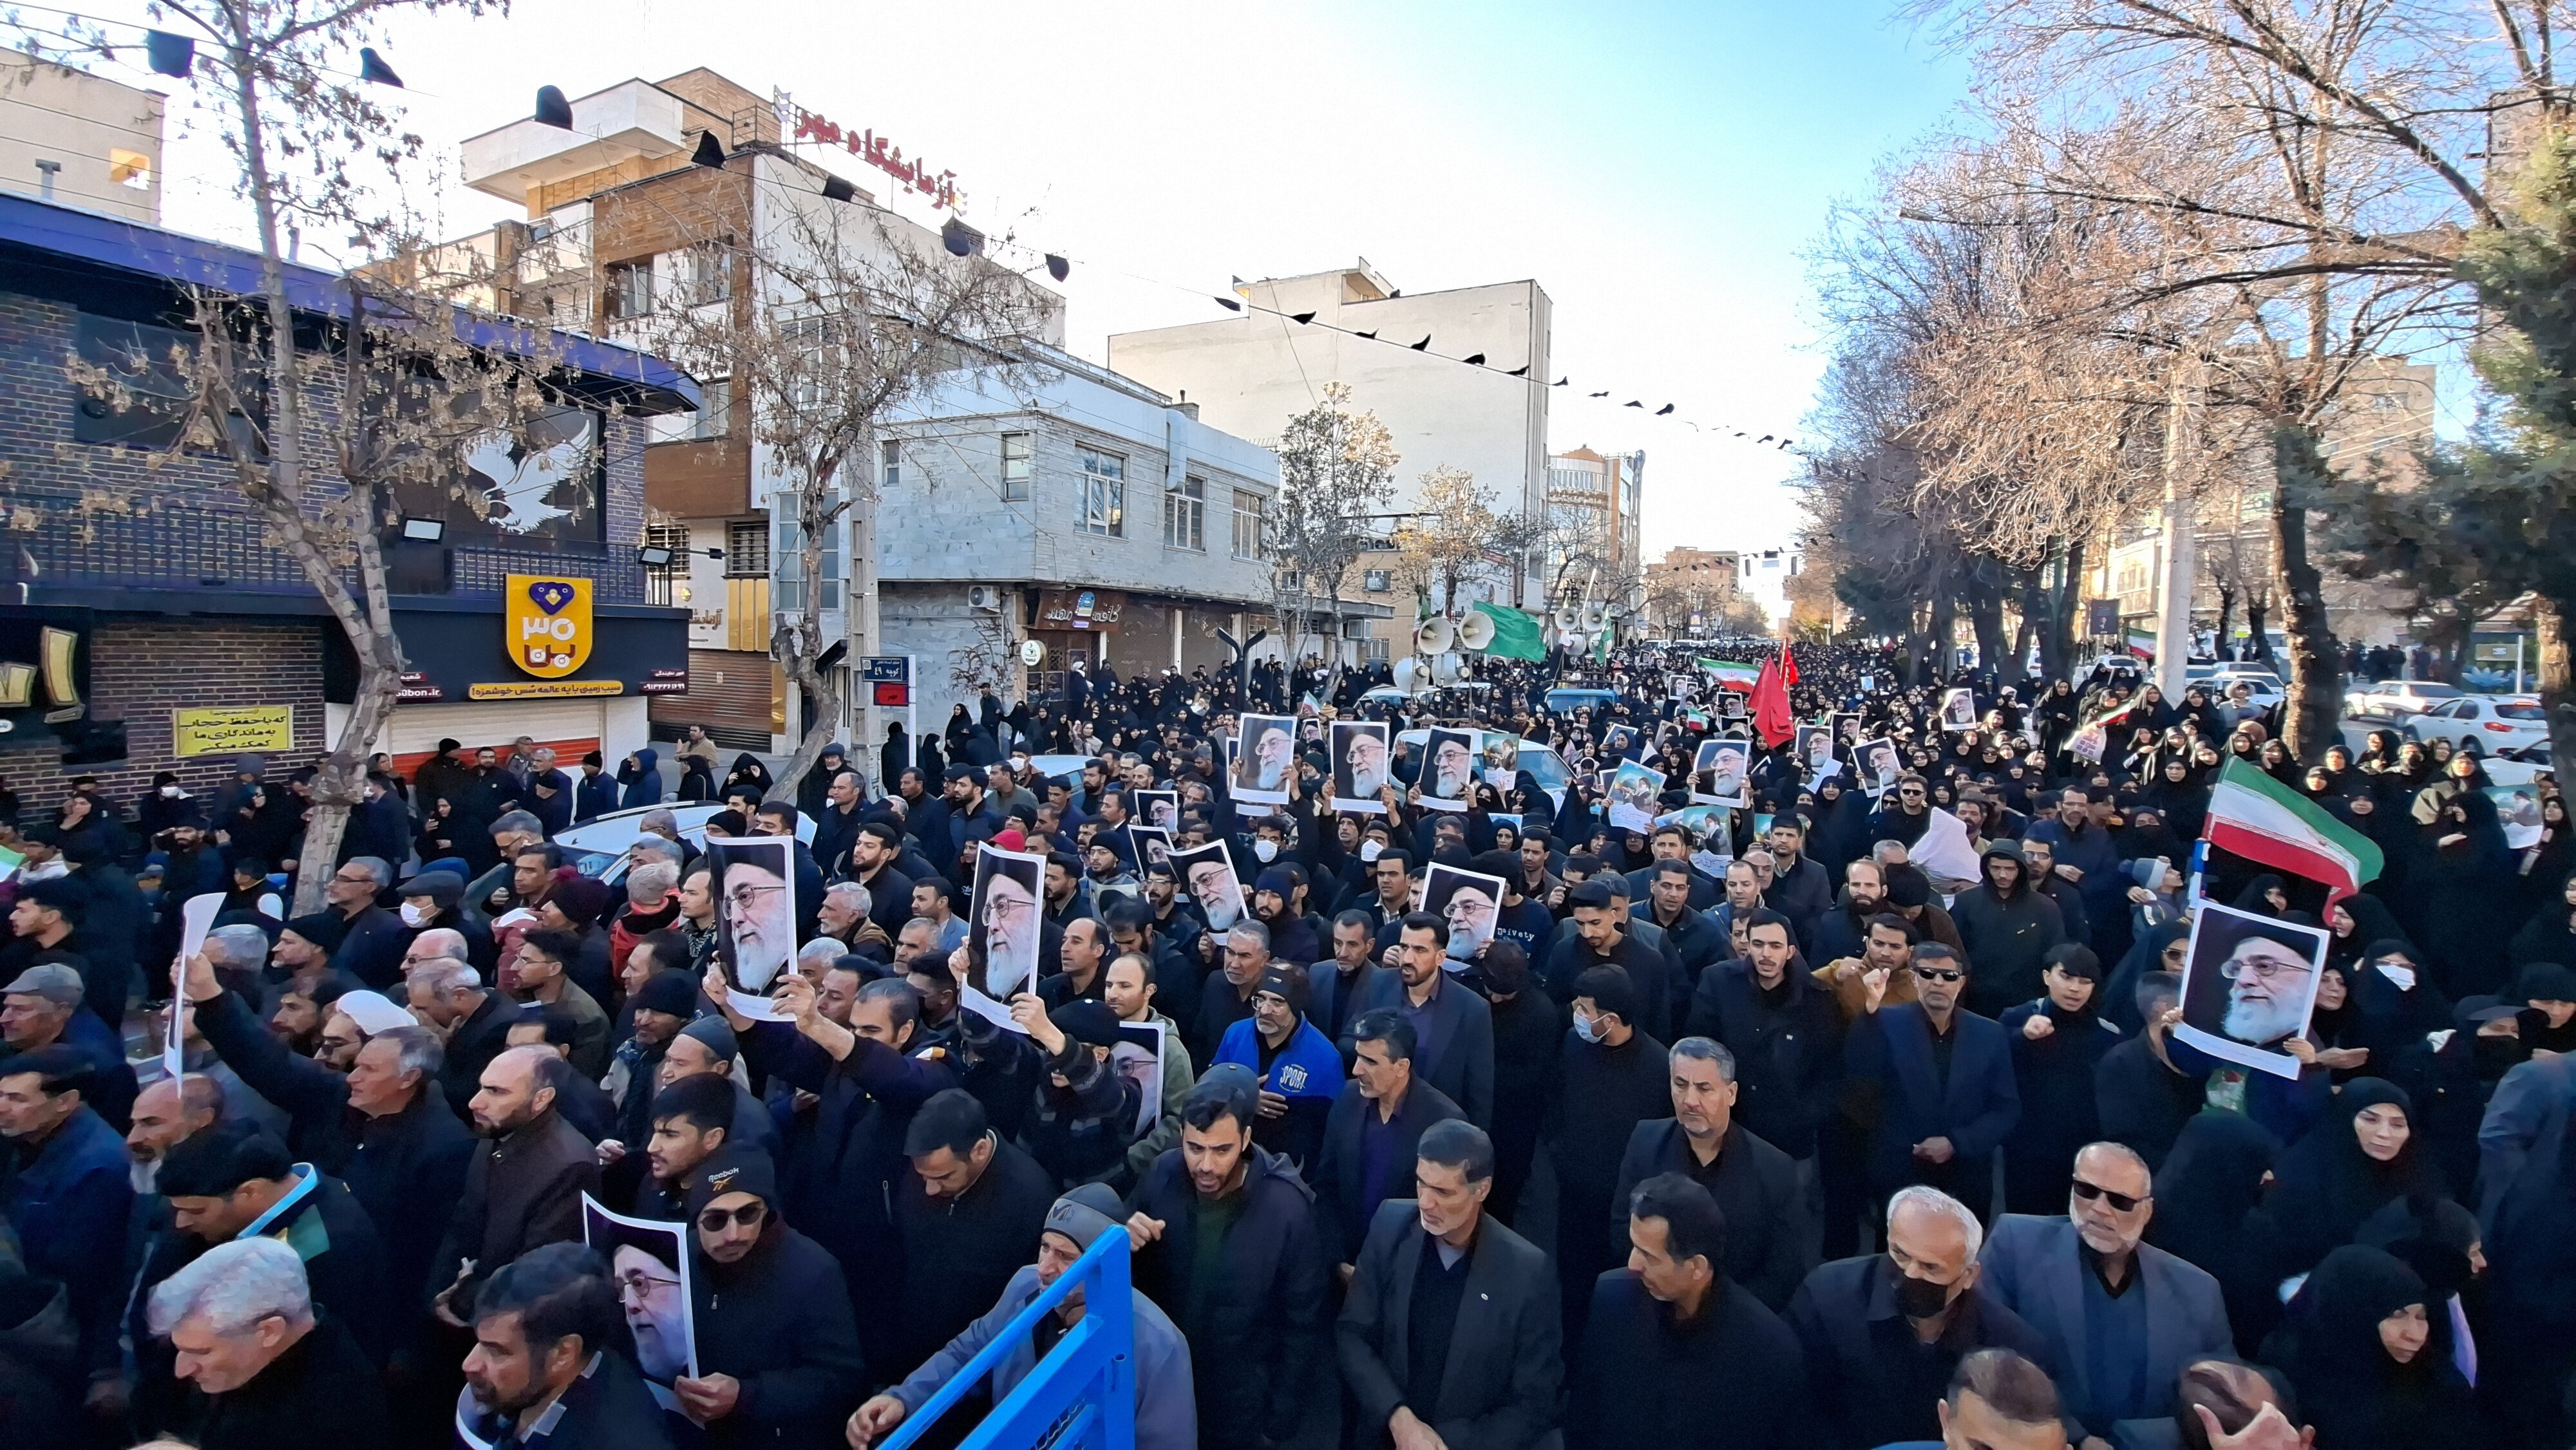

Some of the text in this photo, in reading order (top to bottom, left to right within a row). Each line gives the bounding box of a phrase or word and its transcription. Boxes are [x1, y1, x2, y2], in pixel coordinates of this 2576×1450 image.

[847, 128, 958, 210] آزمایشگاه
[1092, 603, 1122, 623] کافه
[886, 668, 900, 677] کوچه
[572, 684, 579, 693] با
[580, 685, 601, 693] زمینی
[179, 719, 226, 730] حجاب
[1280, 1066, 1308, 1089] SPORT
